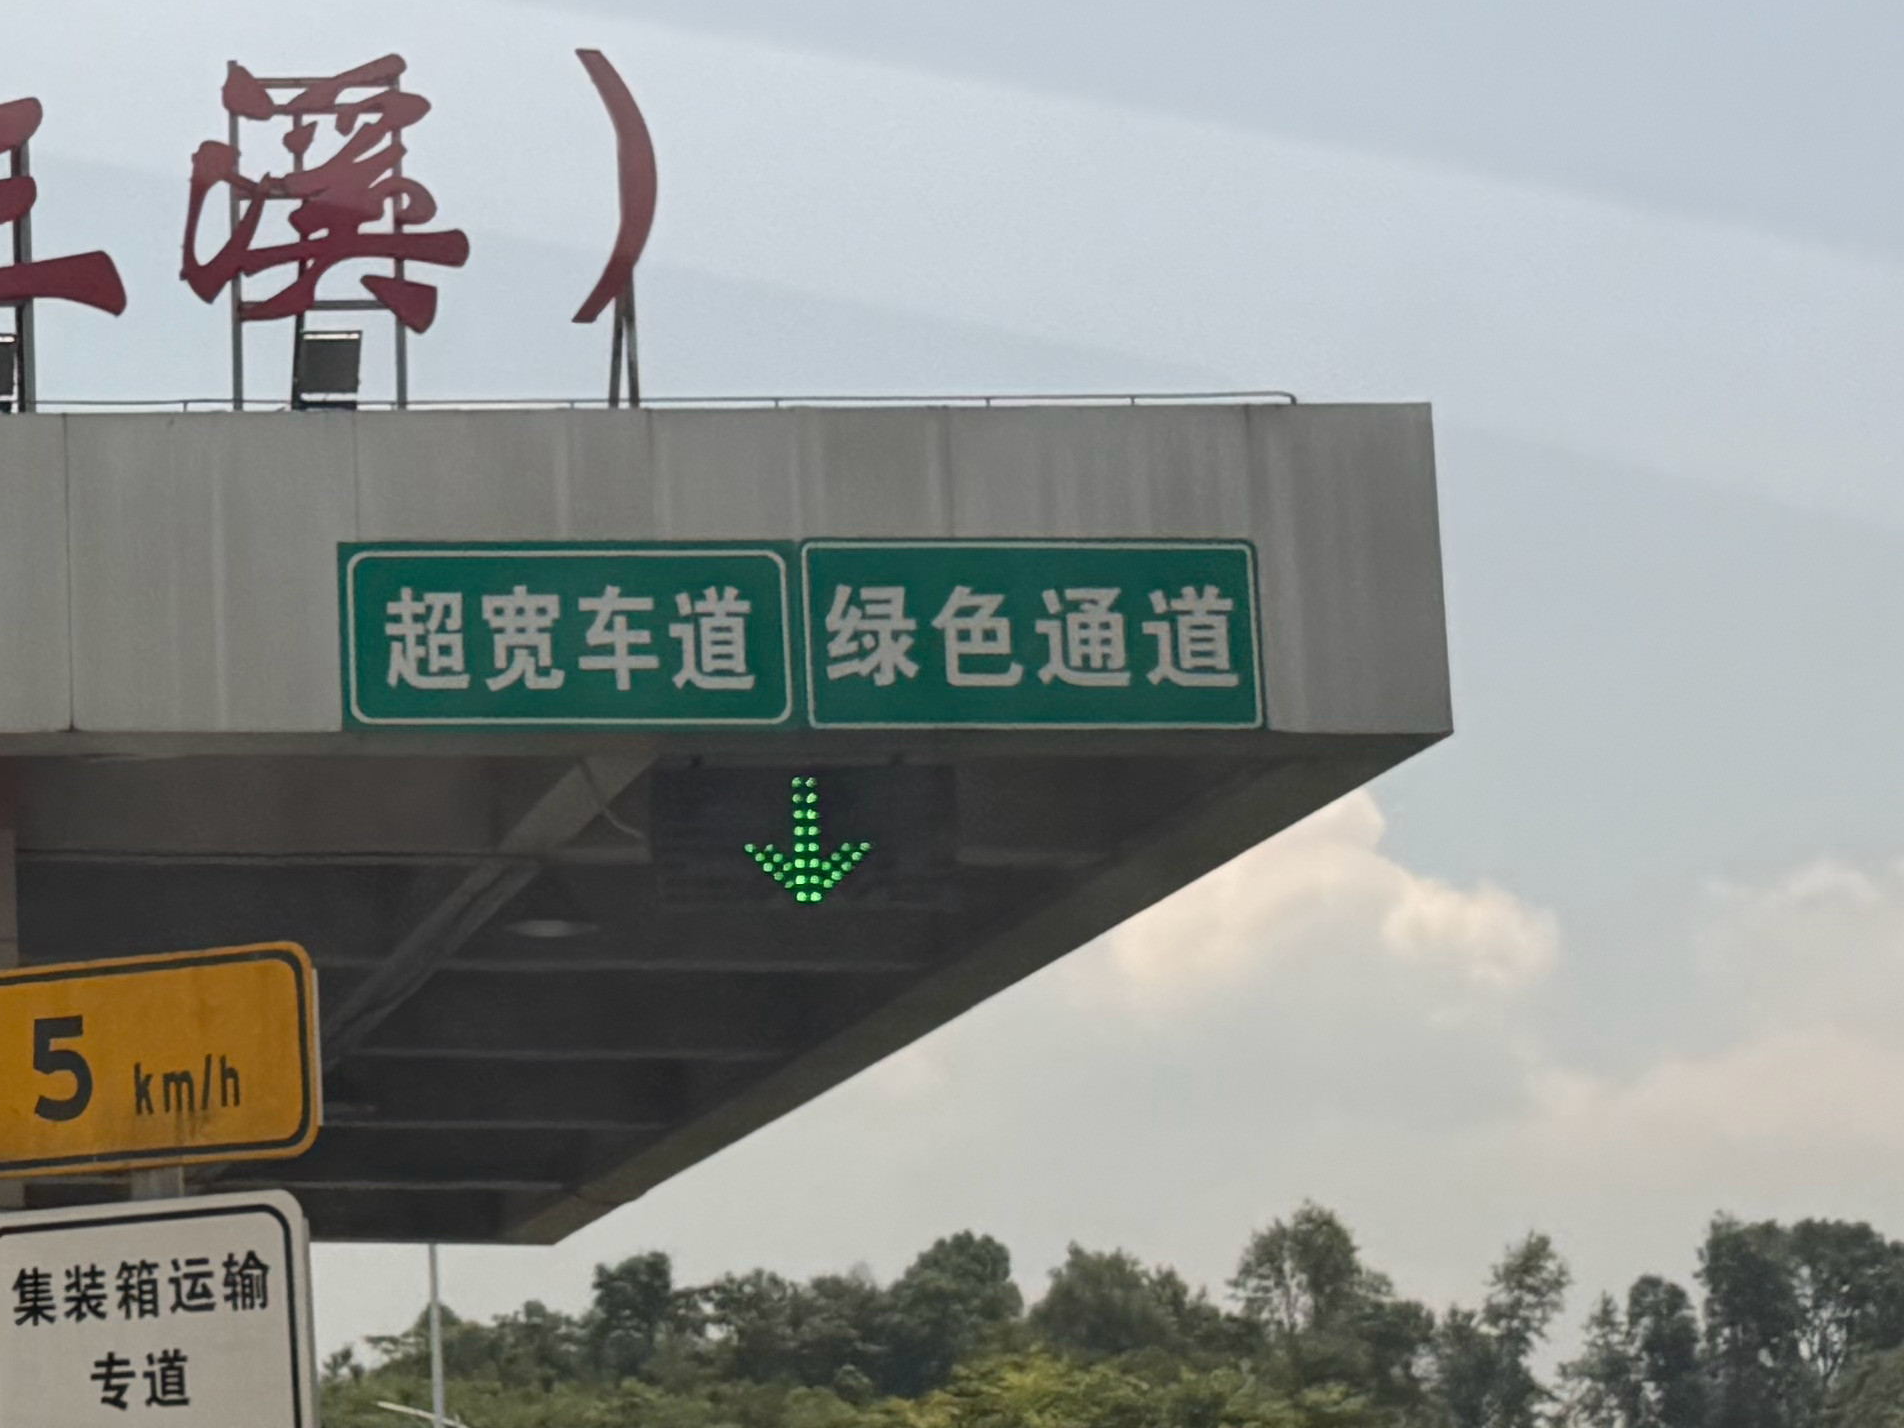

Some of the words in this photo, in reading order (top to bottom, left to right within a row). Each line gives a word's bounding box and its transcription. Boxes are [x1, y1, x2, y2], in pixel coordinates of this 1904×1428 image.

[384, 584, 756, 692] 超宽车道
[824, 583, 1240, 688] 绿色通道
[32, 1014, 93, 1122] 5
[133, 1053, 241, 1116] km/h
[12, 1250, 271, 1327] 集装箱运输
[90, 1348, 191, 1411] 专道
